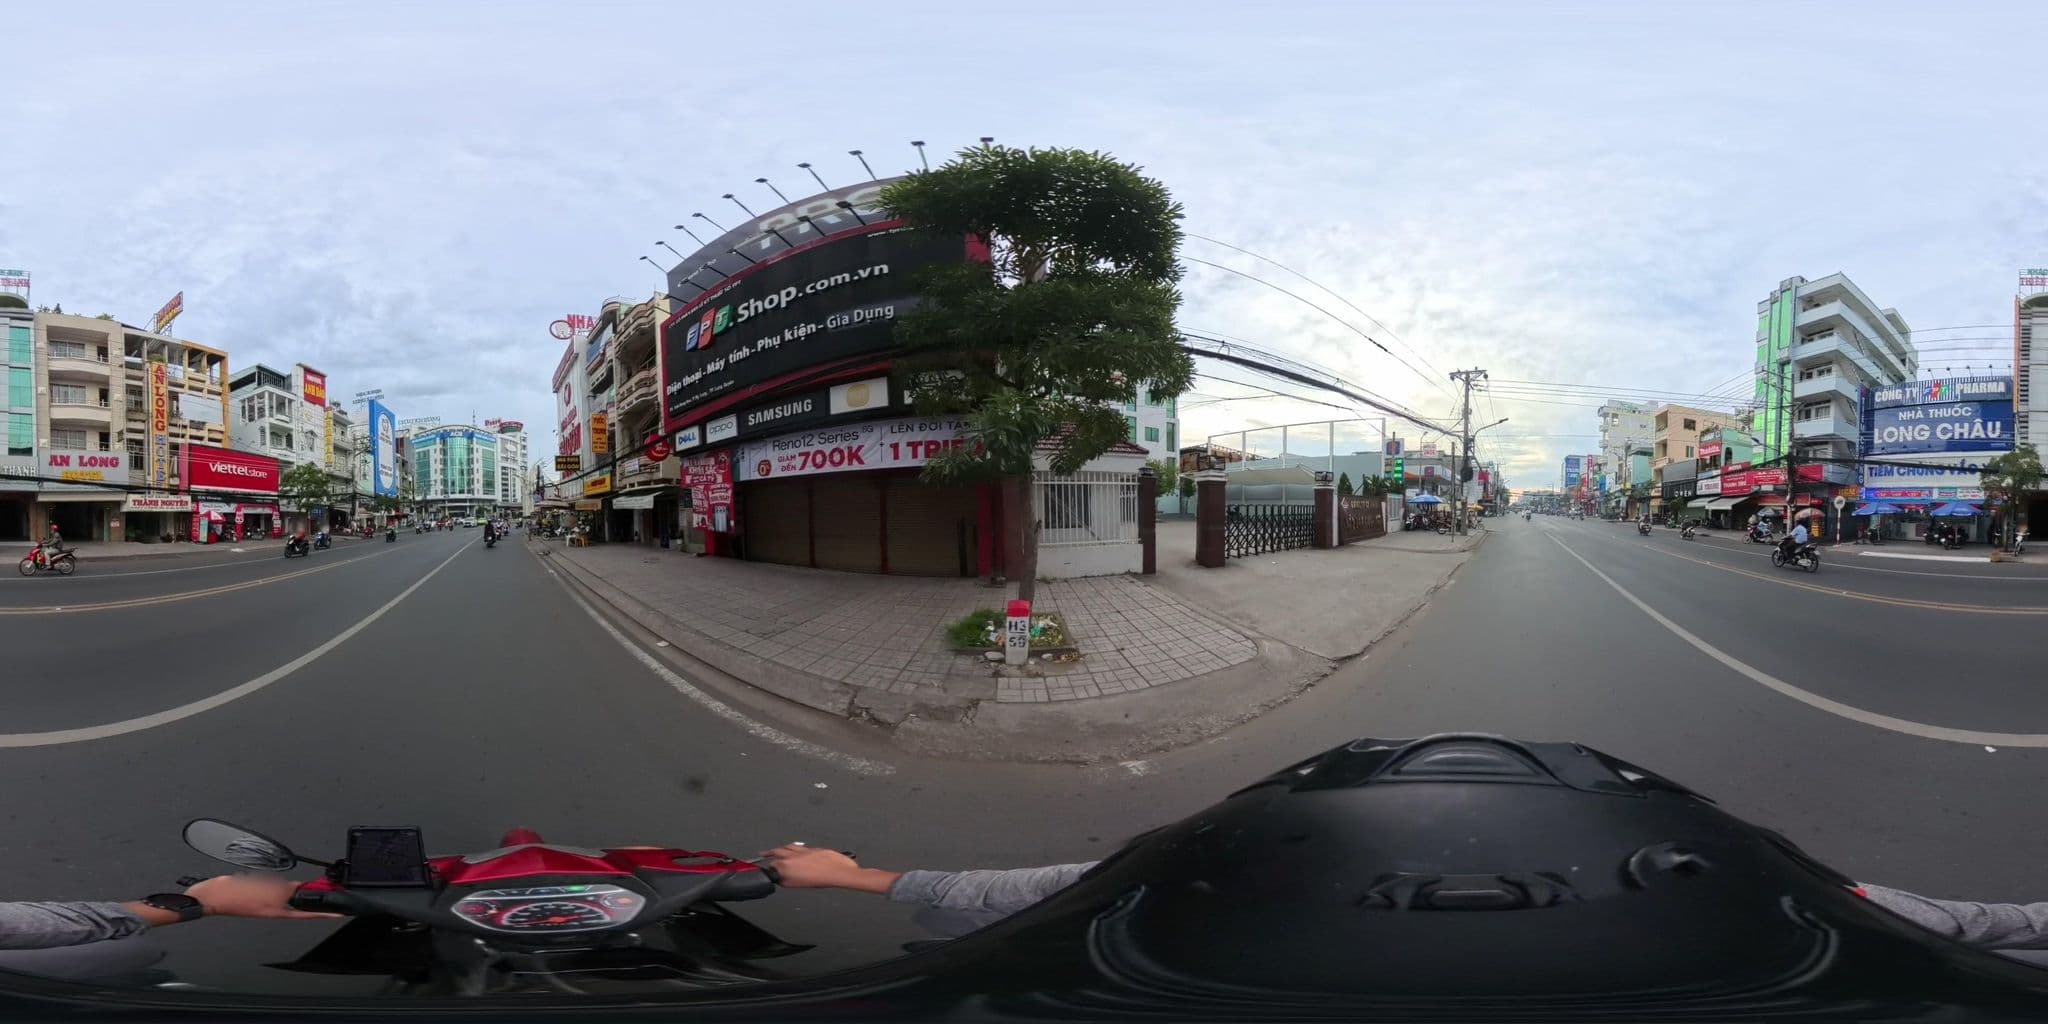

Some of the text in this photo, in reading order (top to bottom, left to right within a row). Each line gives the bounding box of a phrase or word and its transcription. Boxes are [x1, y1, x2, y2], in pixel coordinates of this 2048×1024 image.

[737, 263, 889, 322] Shop.com.vn
[666, 381, 682, 396] Điện
[683, 368, 703, 384] thoại
[707, 358, 726, 375] Máy
[728, 345, 750, 363] tính
[757, 336, 780, 351] Phụ
[784, 323, 817, 341] kiện
[827, 314, 850, 329] Gia
[853, 306, 894, 324] Dụng
[1874, 386, 1904, 403] CÔNG
[1906, 386, 1919, 399] TY
[1957, 382, 2006, 394] PHARMA
[748, 399, 812, 425] SAMSUNG
[1899, 404, 1972, 420] NHÀ THUỐC
[678, 434, 697, 445] DELL
[772, 432, 815, 452] Reno12
[817, 430, 859, 446] Series
[1874, 425, 1931, 444] LONG
[1936, 419, 2001, 440] CHÂU
[49, 455, 119, 468] AN LONG
[799, 444, 865, 471] 700K
[209, 462, 249, 477] viettel
[1009, 620, 1026, 632] H3
